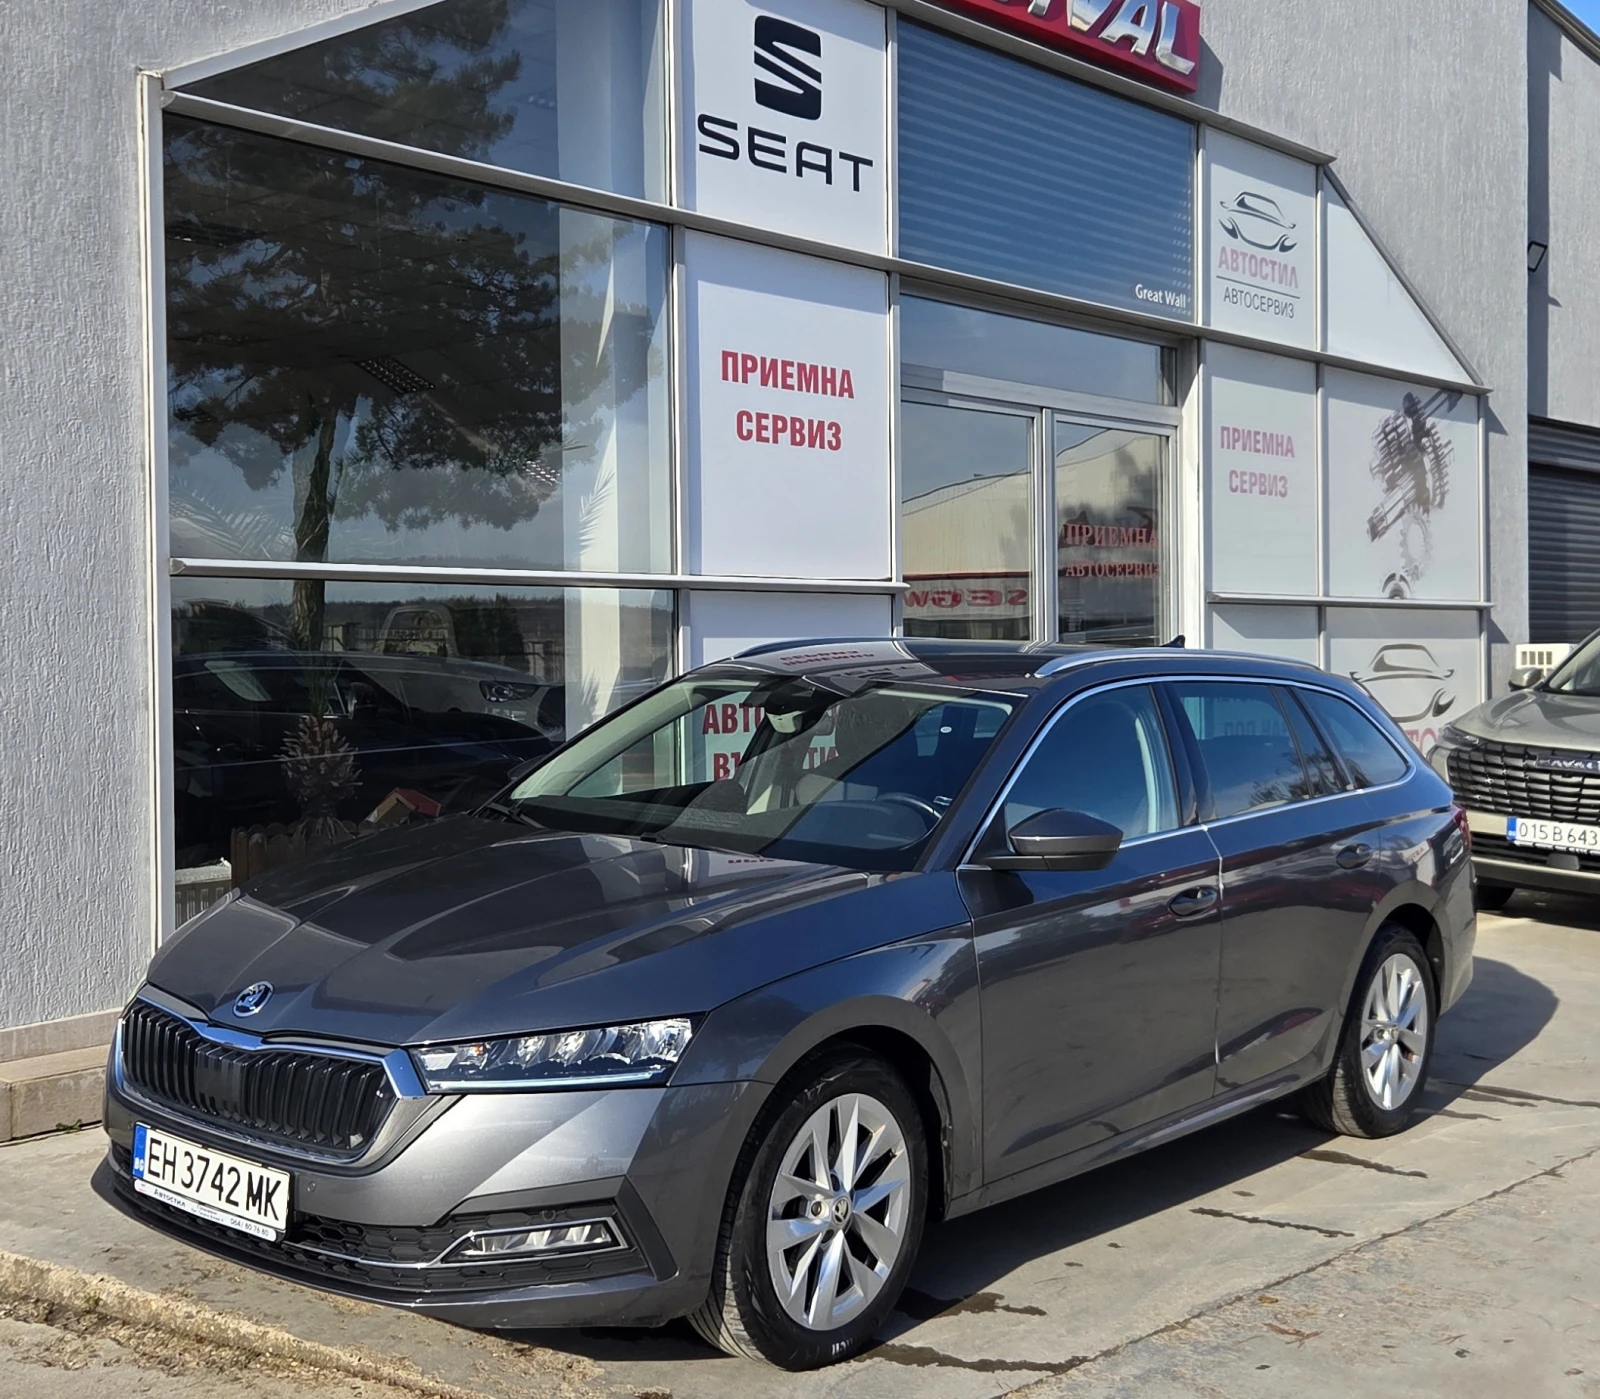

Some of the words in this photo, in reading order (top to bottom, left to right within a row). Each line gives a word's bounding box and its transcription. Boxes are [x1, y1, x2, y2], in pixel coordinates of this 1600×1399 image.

[697, 113, 874, 192] SEAT
[1218, 246, 1298, 289] АВТОСТИЛ
[1135, 284, 1163, 304] Great
[1165, 290, 1186, 309] Wall
[1223, 286, 1295, 319] АВТОСЕРВИЗ
[721, 350, 855, 399] ПРИЕМНА
[736, 409, 842, 451] СЕРВИЗ
[1220, 425, 1295, 458] ПРИЕМНА
[1228, 469, 1288, 498] СЕРВИЗ
[1065, 523, 1158, 547] ПРИЕМНА
